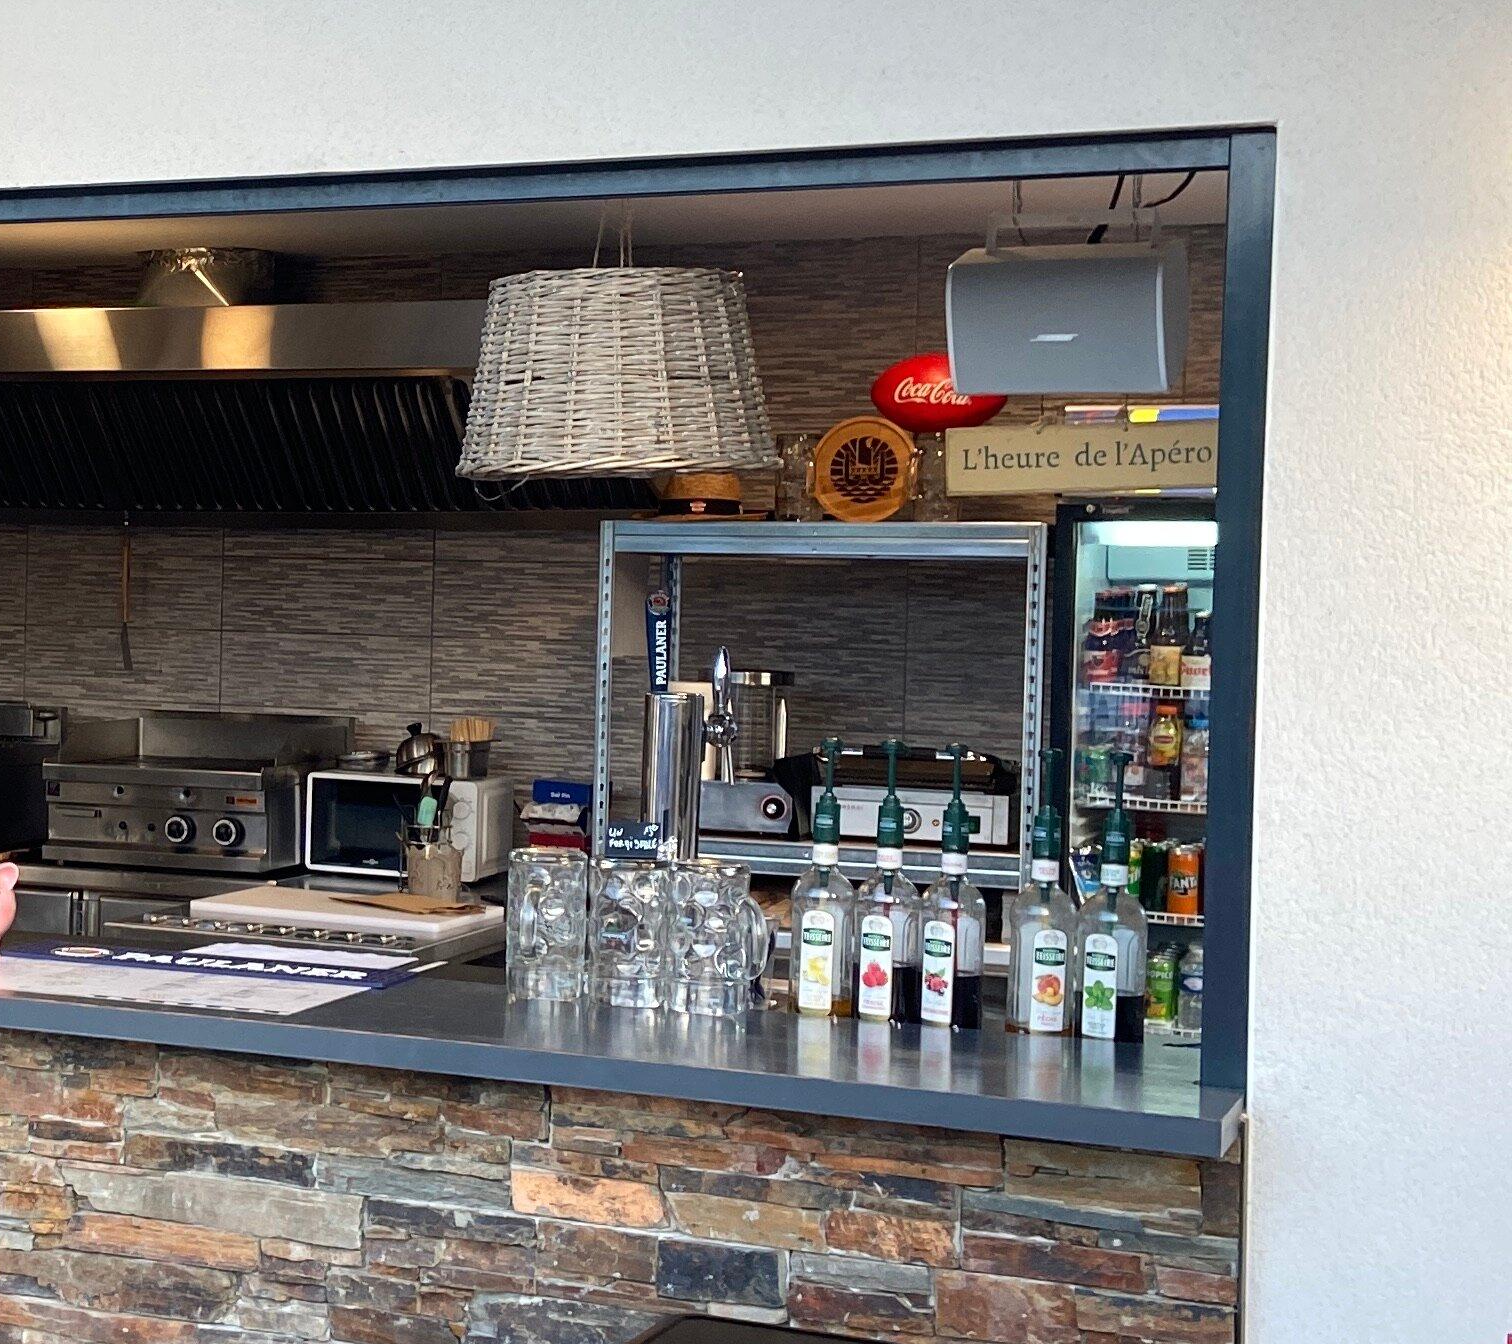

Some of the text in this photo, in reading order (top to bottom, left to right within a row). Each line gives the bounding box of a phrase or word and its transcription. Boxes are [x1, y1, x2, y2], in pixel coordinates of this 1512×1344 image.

[962, 440, 1213, 472] L'heure de l'Apéro
[655, 620, 667, 685] PAULANER
[112, 952, 368, 980] PAULANER
